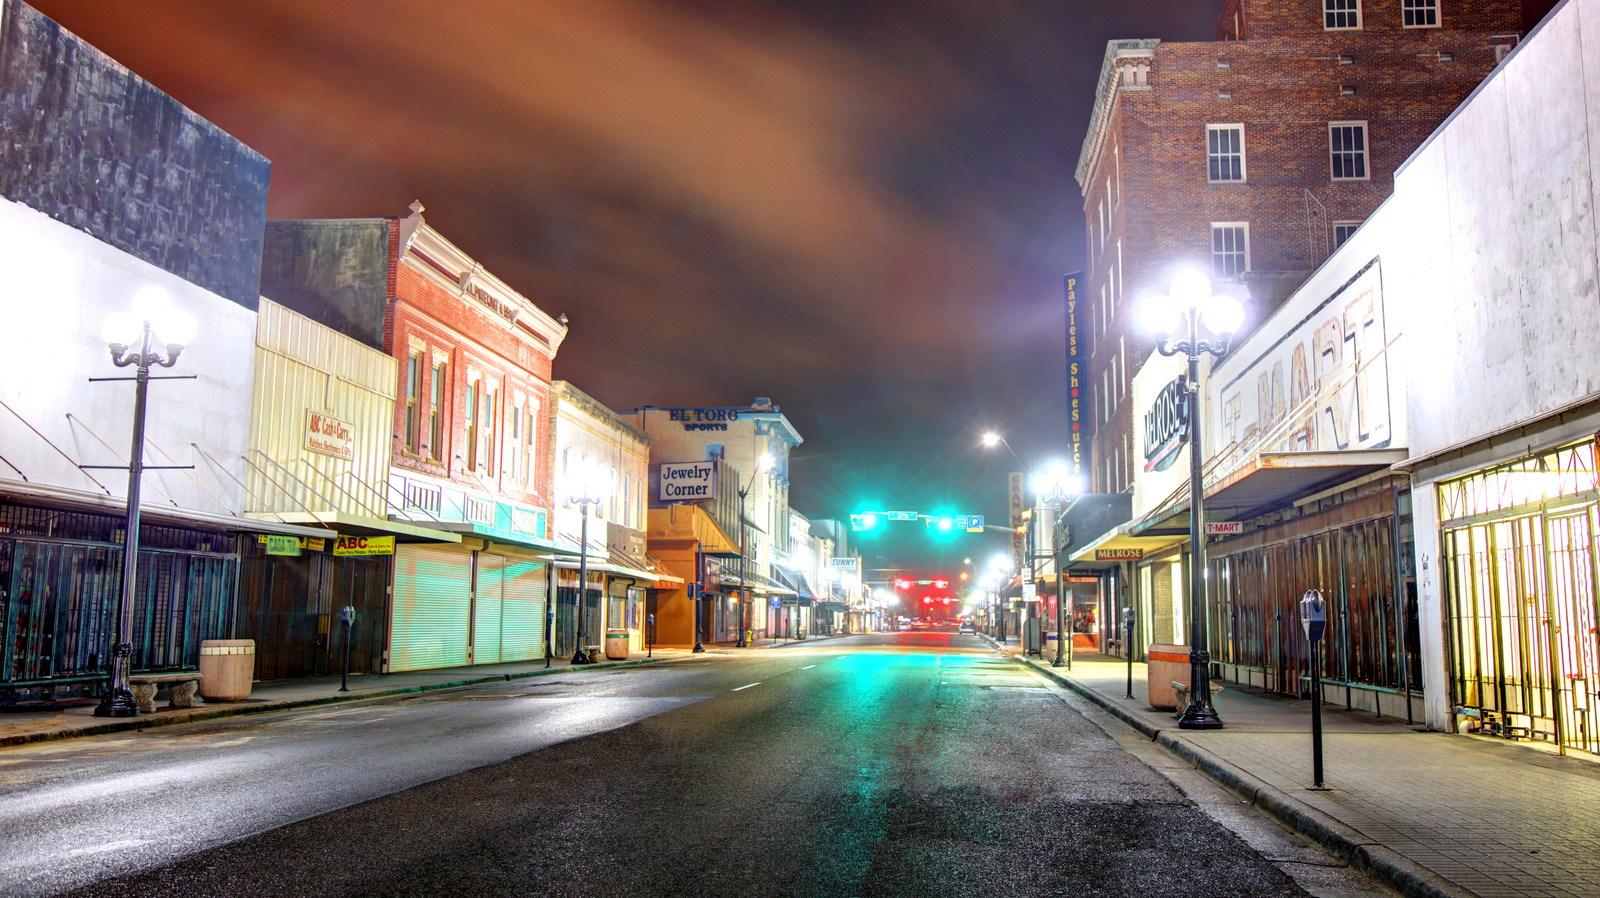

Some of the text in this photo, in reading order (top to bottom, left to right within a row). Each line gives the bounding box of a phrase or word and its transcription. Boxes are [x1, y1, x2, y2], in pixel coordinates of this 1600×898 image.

[1068, 278, 1077, 356] Payless
[670, 408, 738, 421] EL TORO
[1144, 375, 1187, 458] MELROSE
[310, 414, 321, 432] ABC
[322, 418, 333, 436] Cash
[336, 422, 349, 445] Carry
[663, 465, 711, 482] Jewelry
[665, 483, 708, 496] Corner
[1011, 475, 1021, 509] GRAN
[1207, 523, 1240, 533] T-MART
[336, 537, 368, 550] ABC
[1098, 549, 1142, 558] MELROSE
[831, 558, 856, 567] SUNNY
